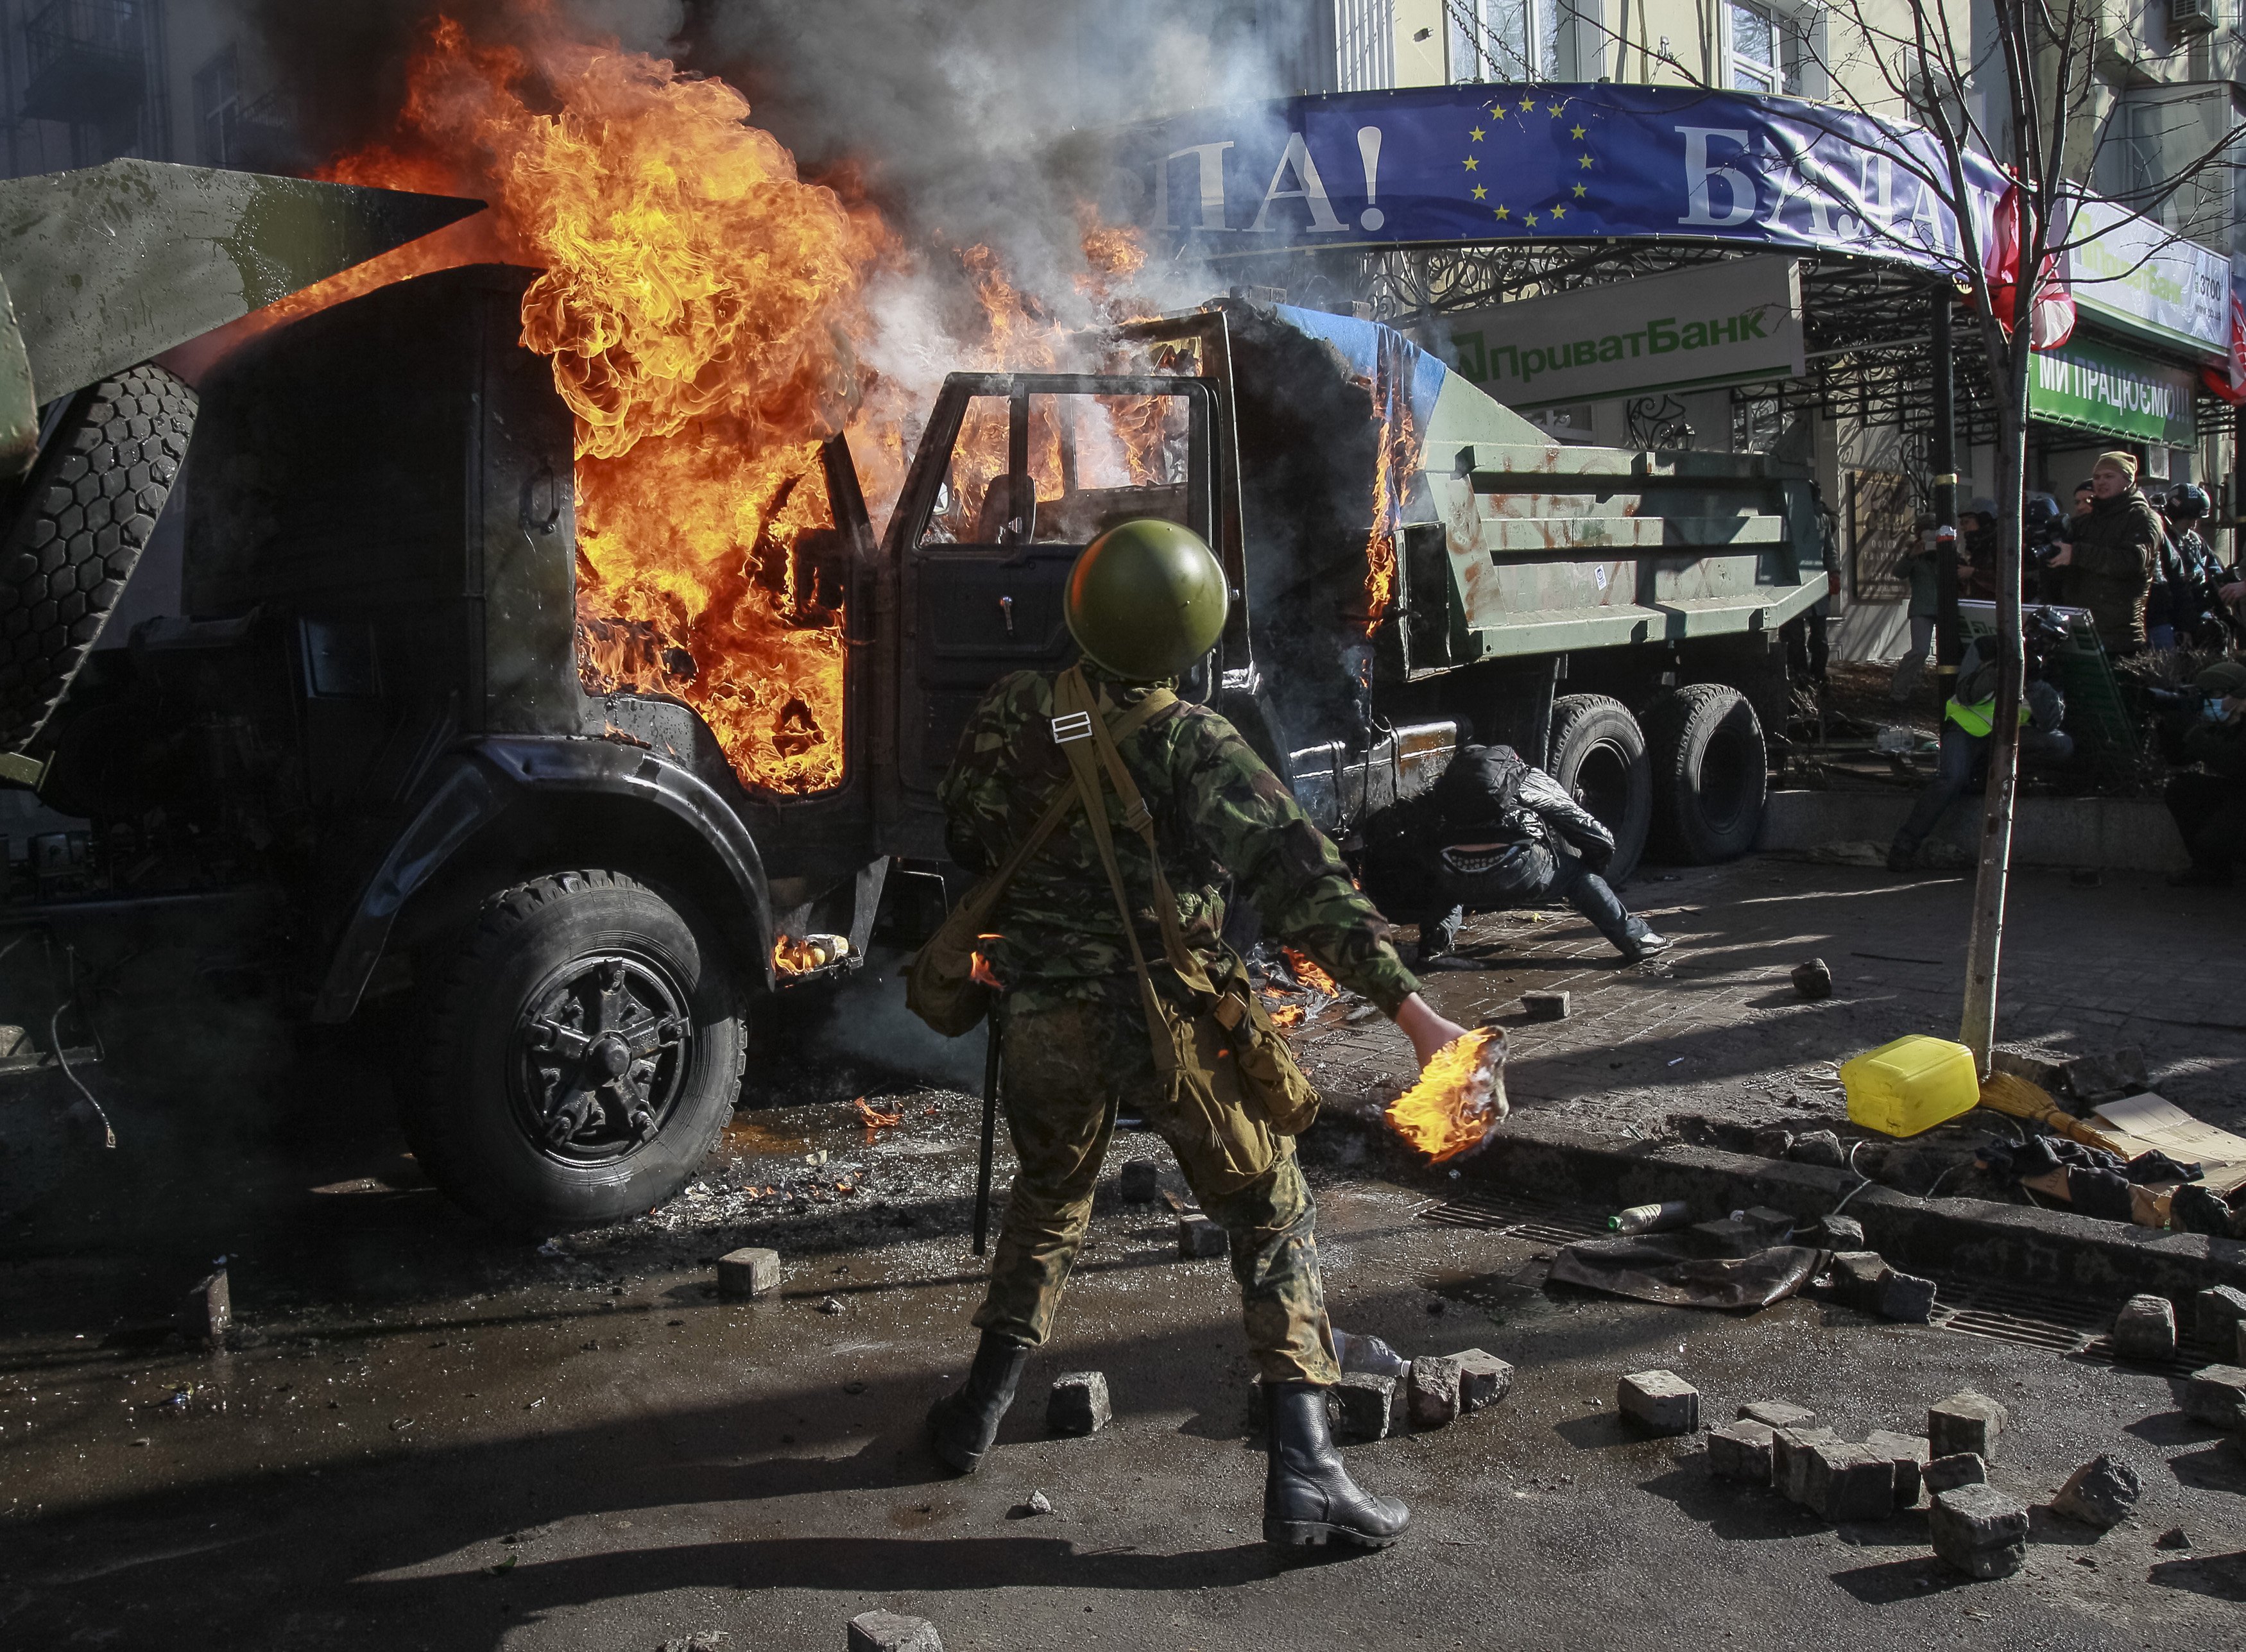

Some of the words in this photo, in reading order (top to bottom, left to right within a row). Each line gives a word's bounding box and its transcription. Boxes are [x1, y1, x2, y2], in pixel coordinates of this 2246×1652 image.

[1101, 126, 1383, 232] ПА!
[2200, 274, 2221, 302] 3700
[1487, 311, 1770, 383] ПриватБанк
[2039, 349, 2070, 395] МИ
